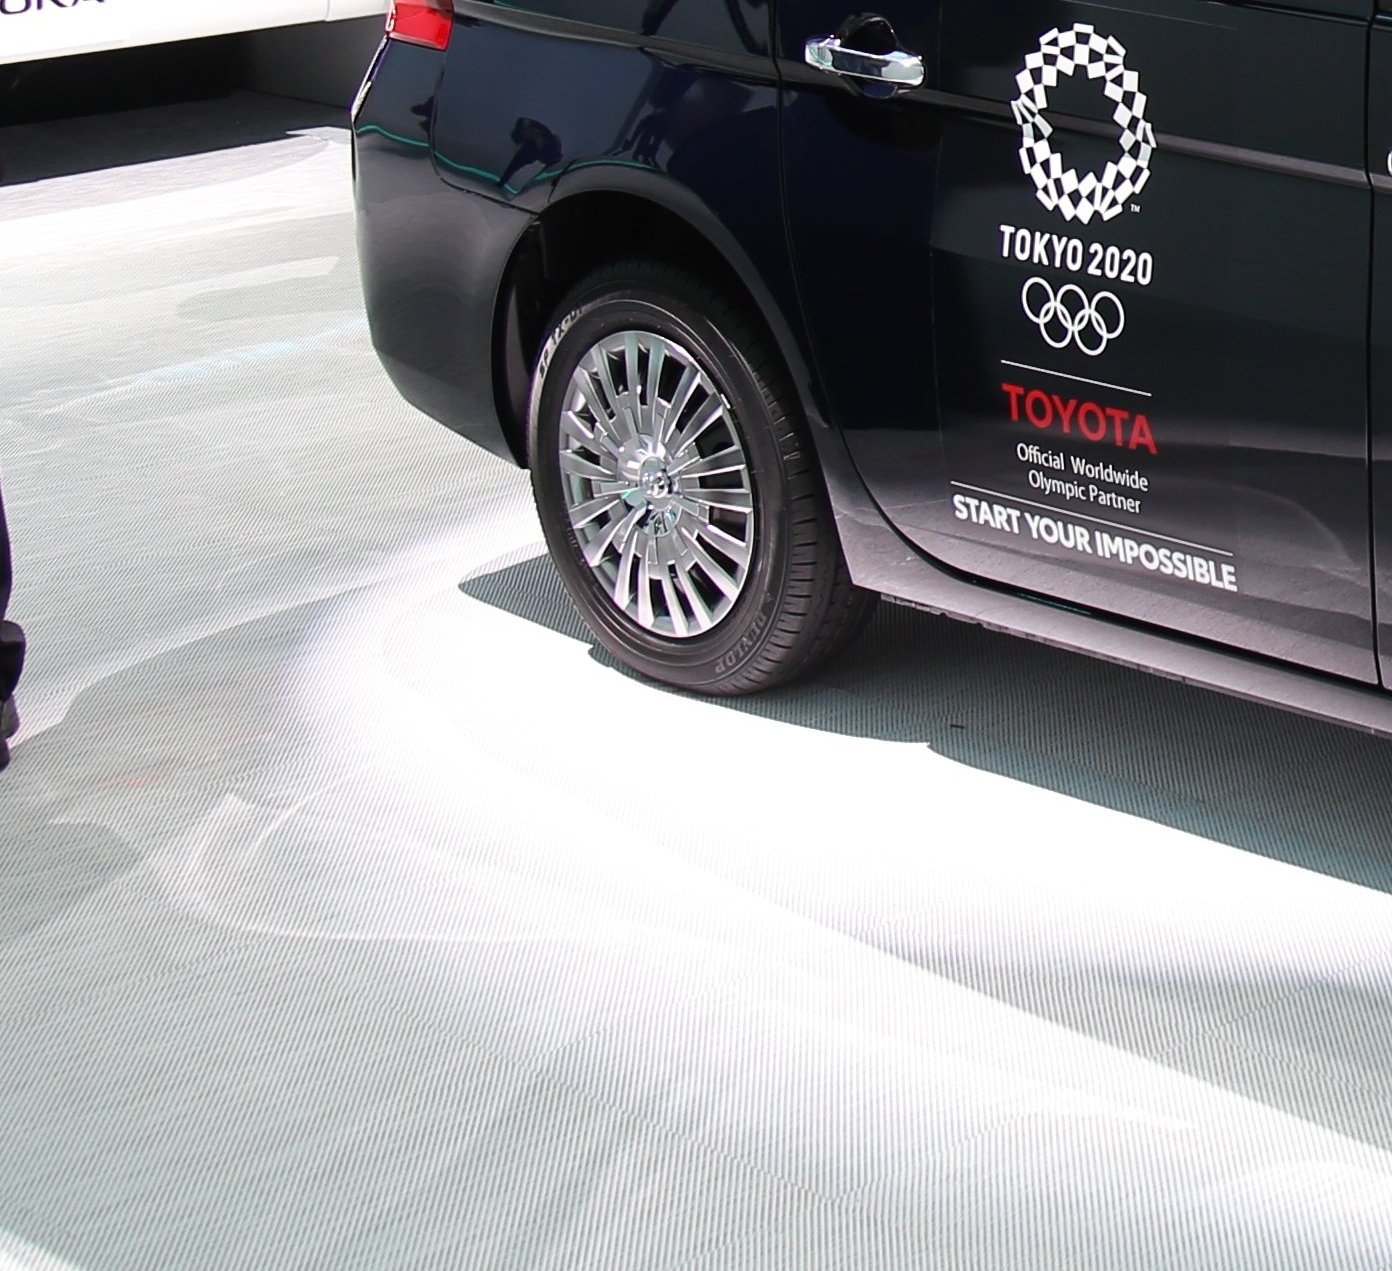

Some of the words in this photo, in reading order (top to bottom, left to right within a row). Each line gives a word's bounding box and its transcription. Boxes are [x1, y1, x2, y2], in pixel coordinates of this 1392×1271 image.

[1000, 224, 1083, 271] TOKYO
[1087, 242, 1153, 285] 2020
[1001, 382, 1159, 455] TOYOTA
[1016, 442, 1065, 471] Official
[1070, 455, 1149, 492] Worldwide
[1028, 469, 1086, 501] Olympic
[1089, 484, 1141, 514] Partner
[952, 494, 1020, 534] START
[1023, 512, 1093, 554] YOUR
[1095, 531, 1238, 592] IMPOSSIBLE
